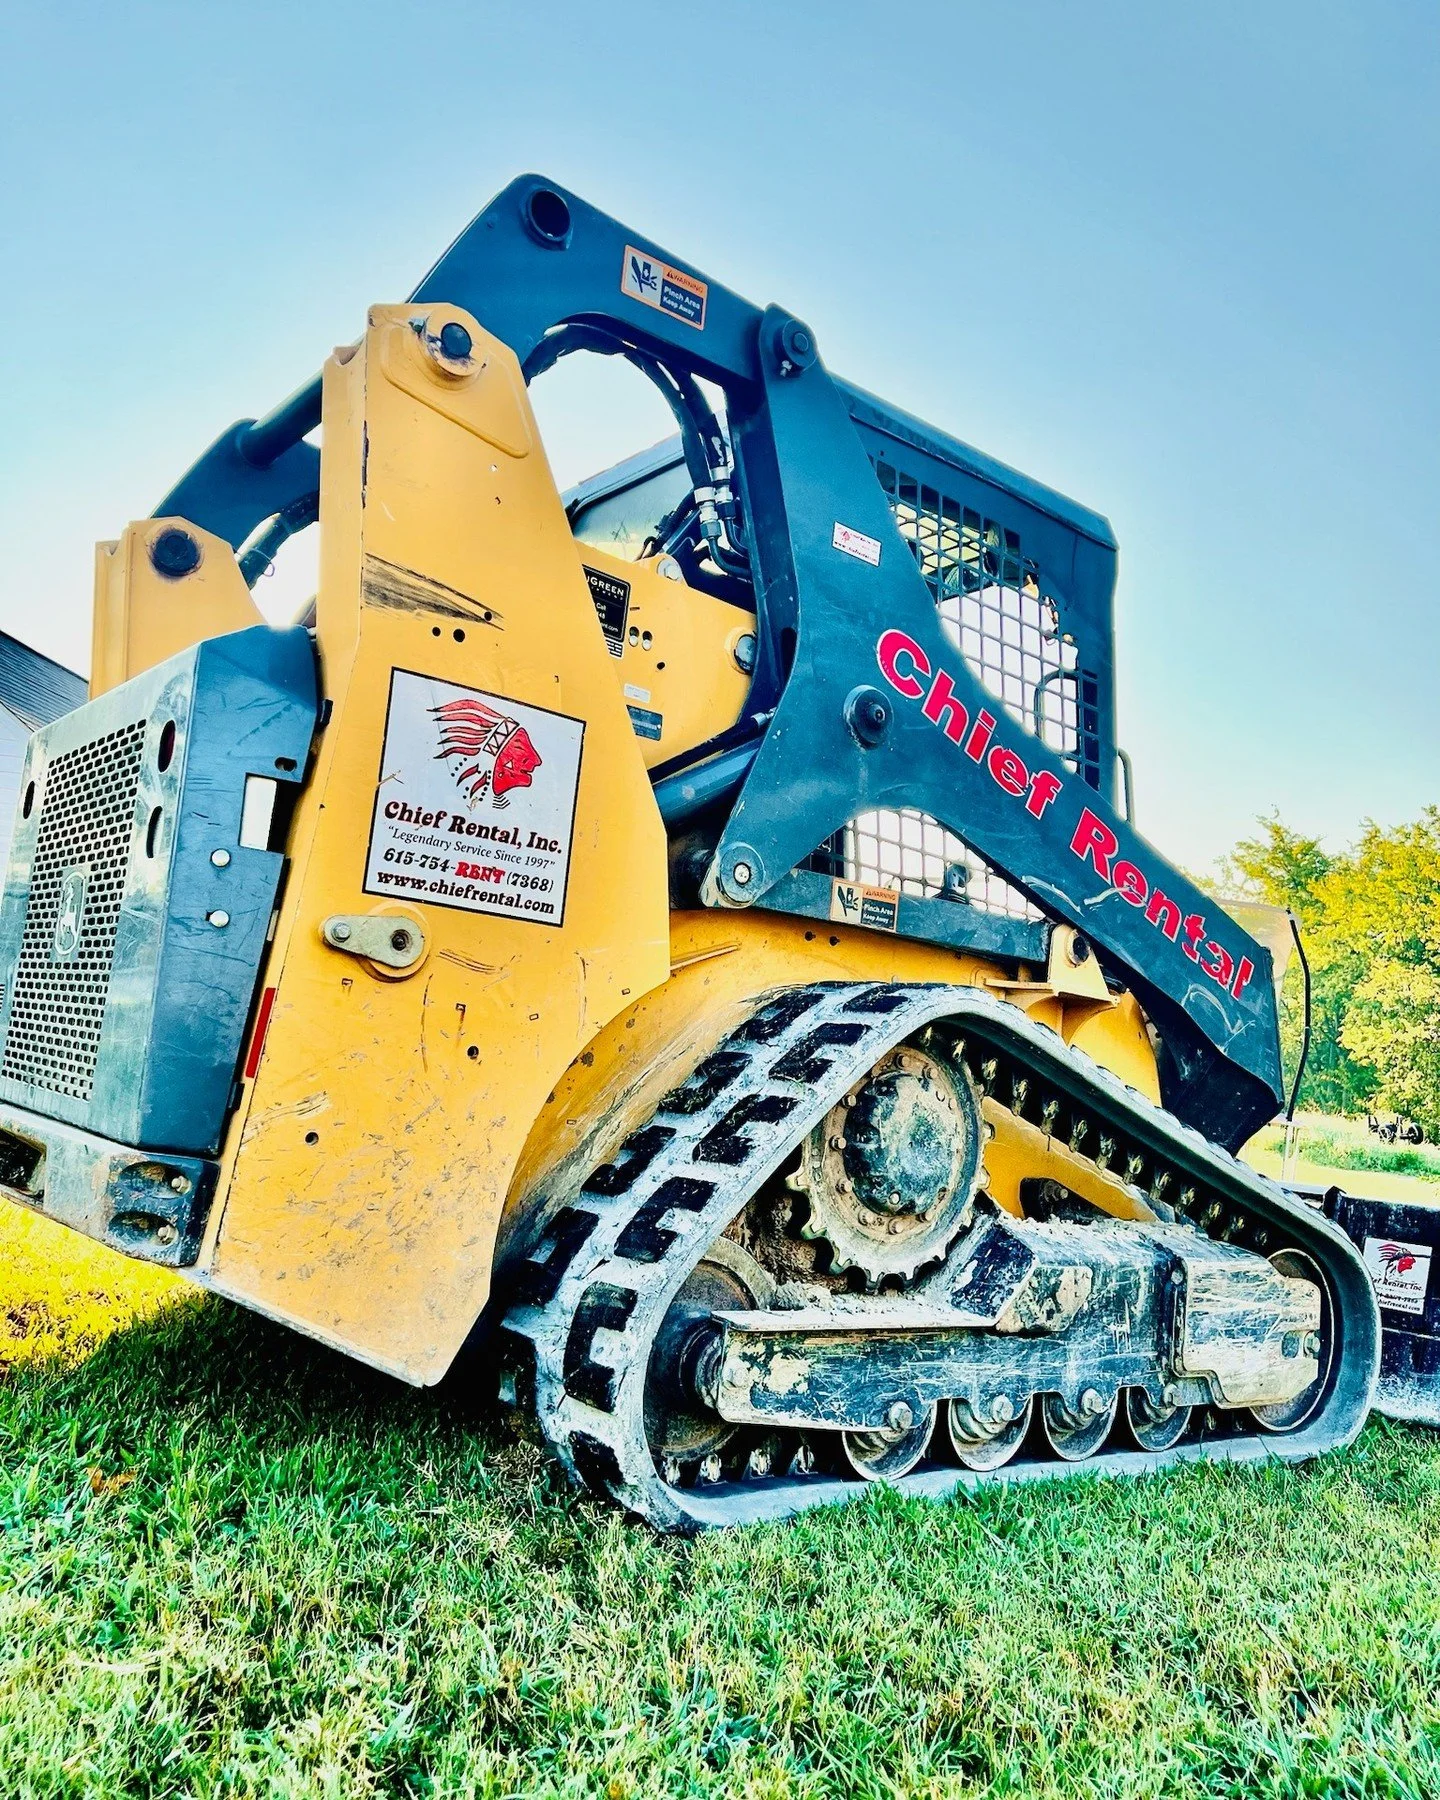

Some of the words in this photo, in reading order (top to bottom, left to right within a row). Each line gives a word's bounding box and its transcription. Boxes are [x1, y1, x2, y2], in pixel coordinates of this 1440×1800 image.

[662, 296, 679, 310] Keep
[679, 303, 695, 317] Away
[664, 285, 684, 301] Pinch
[684, 296, 701, 310] Area
[876, 628, 1064, 820] Chief
[1069, 806, 1255, 1001] Rental
[384, 801, 448, 829] Chief
[447, 815, 522, 849] Rental,
[526, 831, 562, 854] Inc.
[453, 840, 492, 857] Service
[494, 849, 522, 864] Since
[377, 872, 555, 914] www.chiefrental.com
[506, 871, 554, 893] (7368)
[871, 890, 896, 901] WARNING
[863, 913, 876, 921] Keep
[876, 916, 889, 924] Away
[864, 903, 880, 913] Pinch
[880, 907, 894, 916] Area
